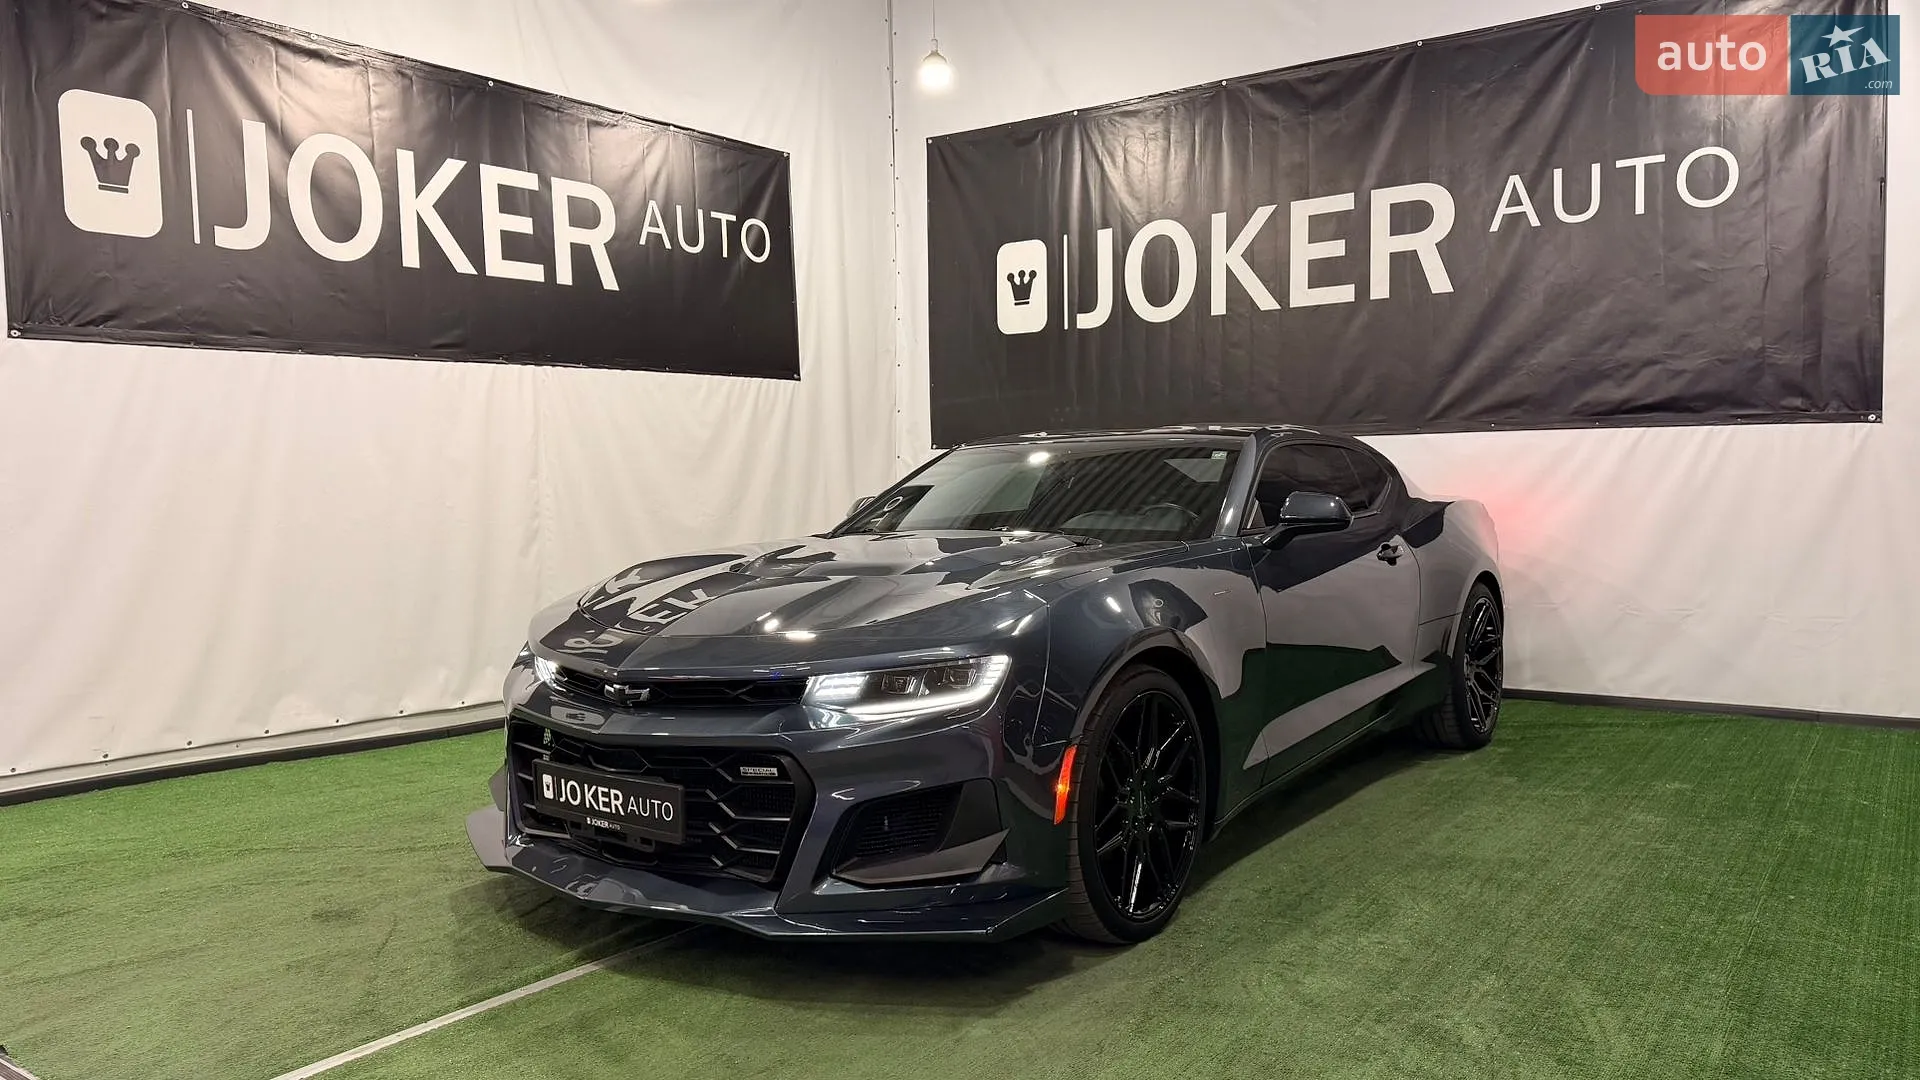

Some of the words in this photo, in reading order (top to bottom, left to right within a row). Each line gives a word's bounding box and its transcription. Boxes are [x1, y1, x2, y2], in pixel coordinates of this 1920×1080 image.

[214, 119, 619, 290] JOKER
[640, 200, 771, 263] AUTO
[1076, 182, 1456, 329] JOKER
[1489, 146, 1740, 232] AUTO
[560, 779, 624, 815] JOKER
[627, 796, 673, 821] AUTO
